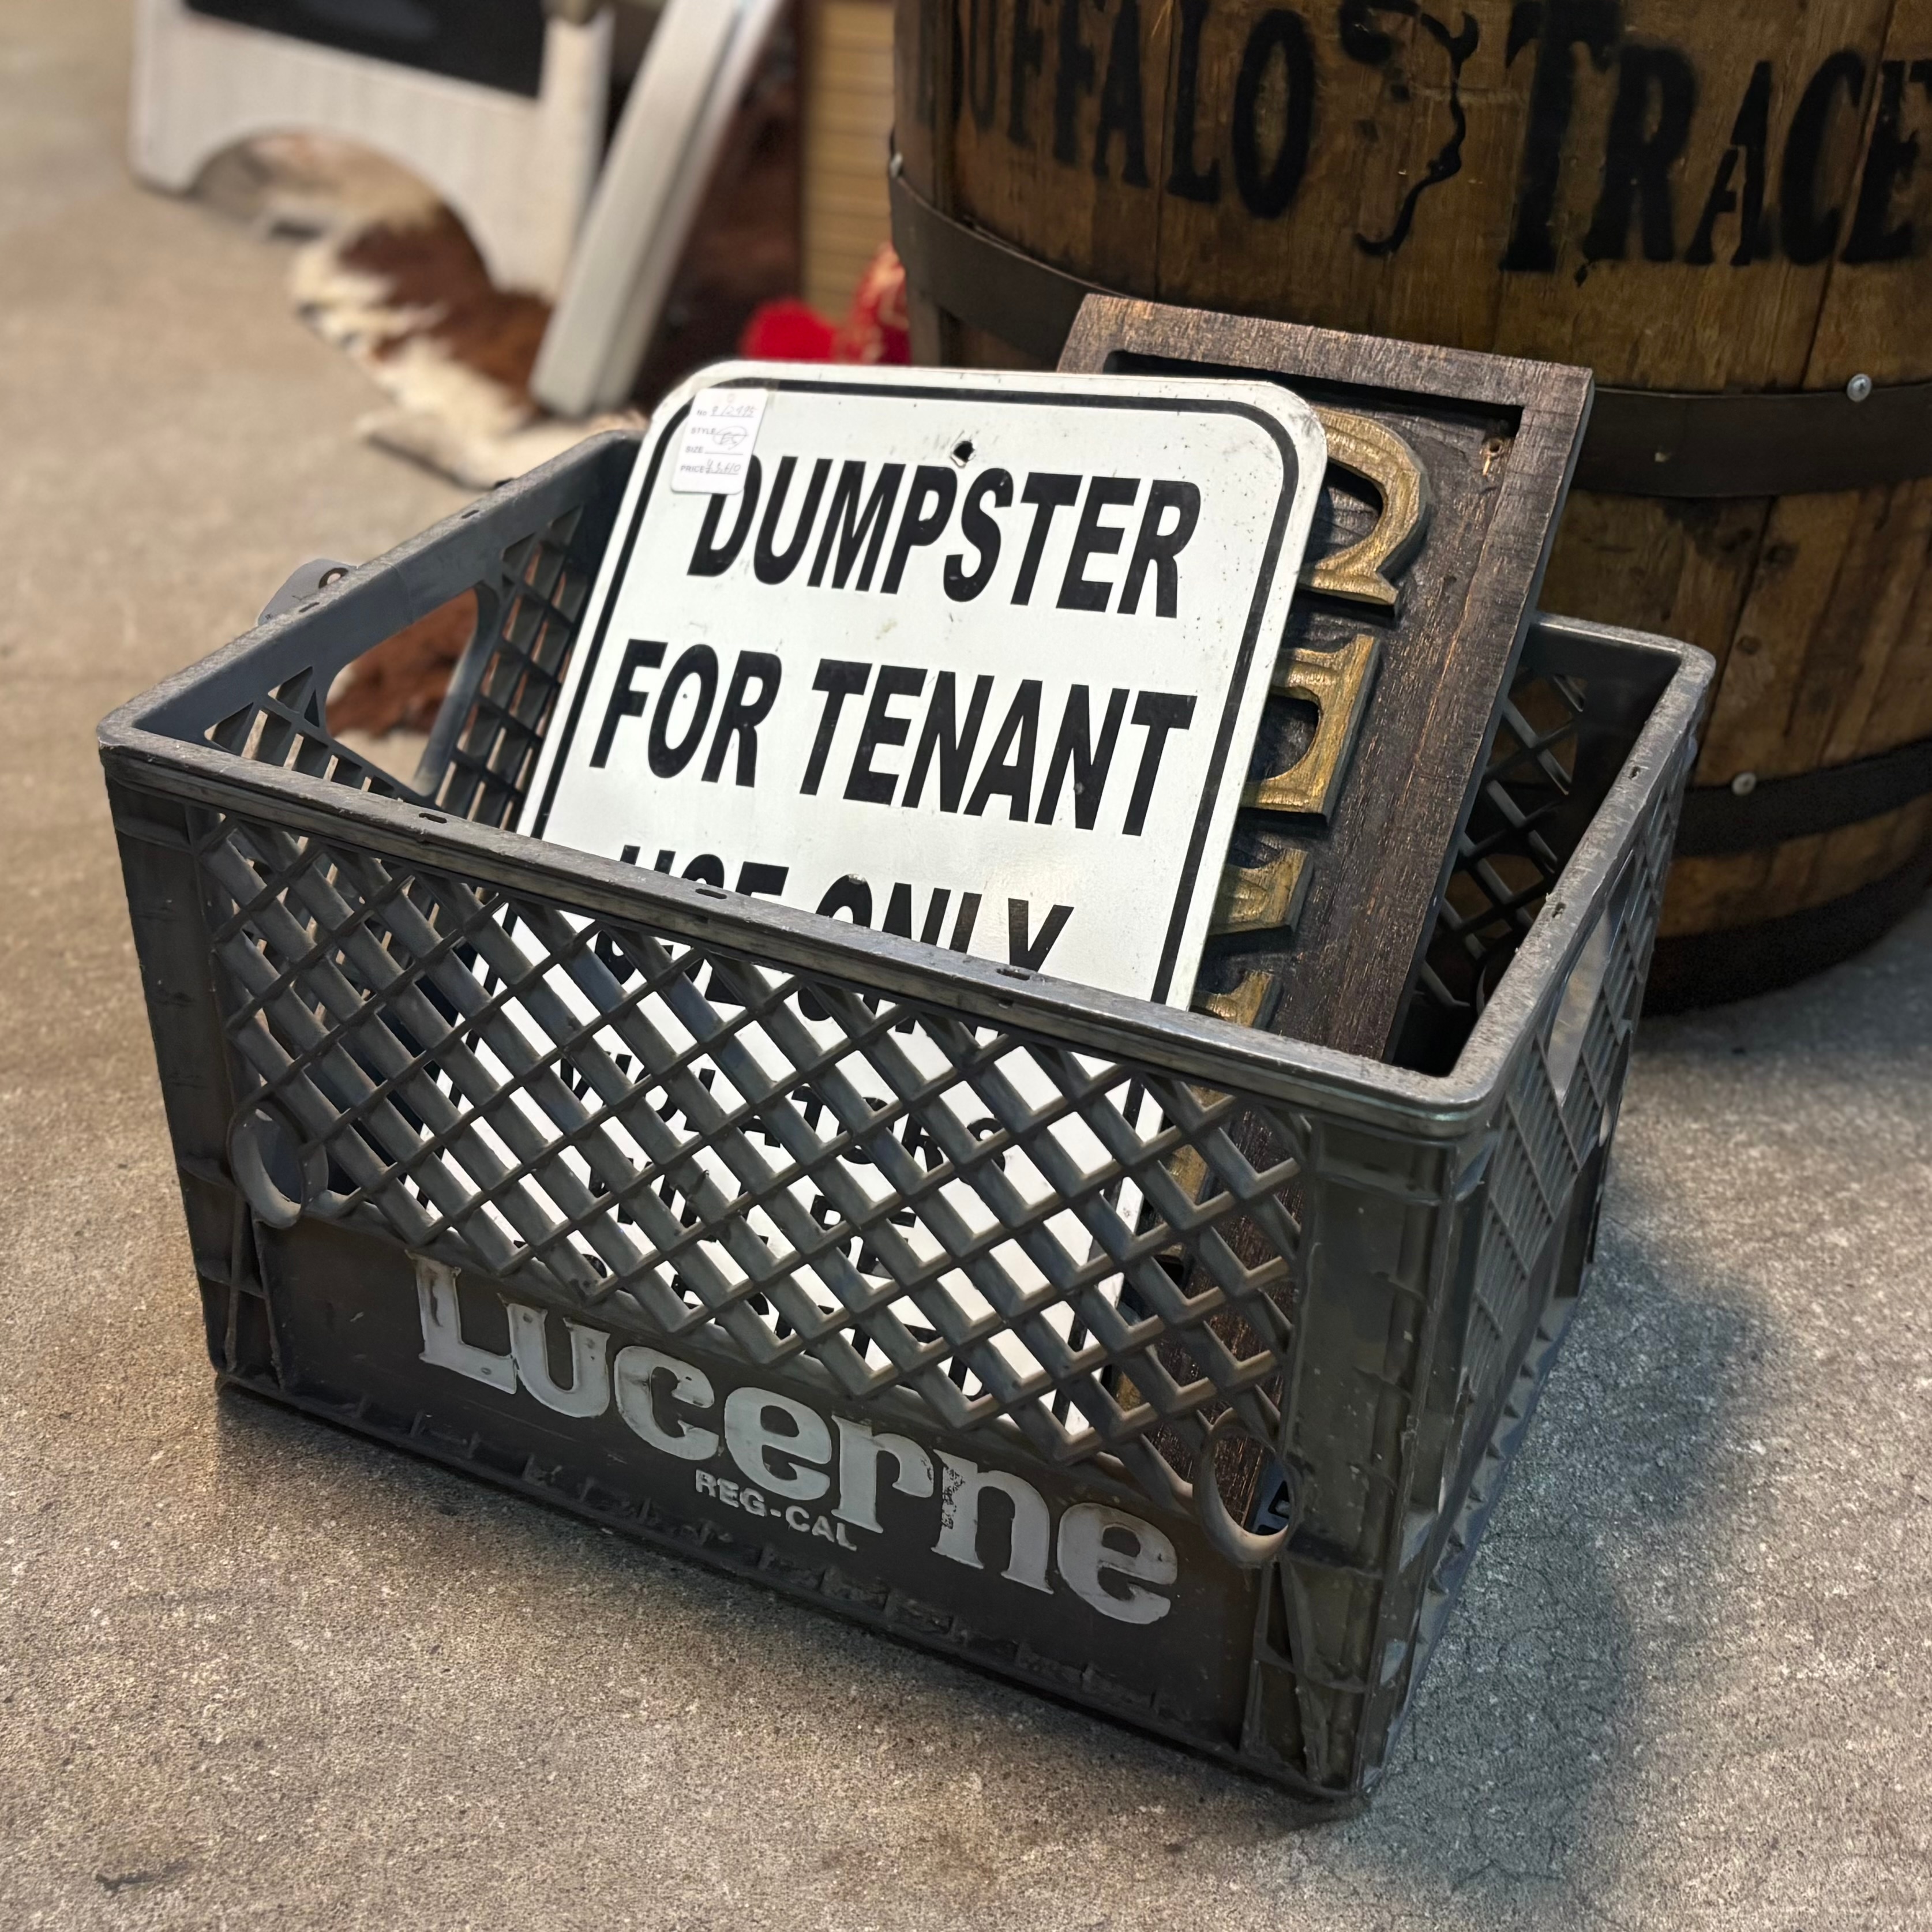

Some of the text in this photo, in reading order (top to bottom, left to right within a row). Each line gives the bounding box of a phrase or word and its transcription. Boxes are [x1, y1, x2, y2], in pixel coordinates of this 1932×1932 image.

[1498, 0, 1932, 271] TRACE
[680, 464, 705, 474] PRICE
[685, 445, 704, 453] SIZE
[686, 455, 1201, 618] DUMPSTER
[589, 639, 1197, 836] FOR TENANT
[407, 1251, 1178, 1625] Lucerne
[695, 1469, 858, 1551] REG-CAL
